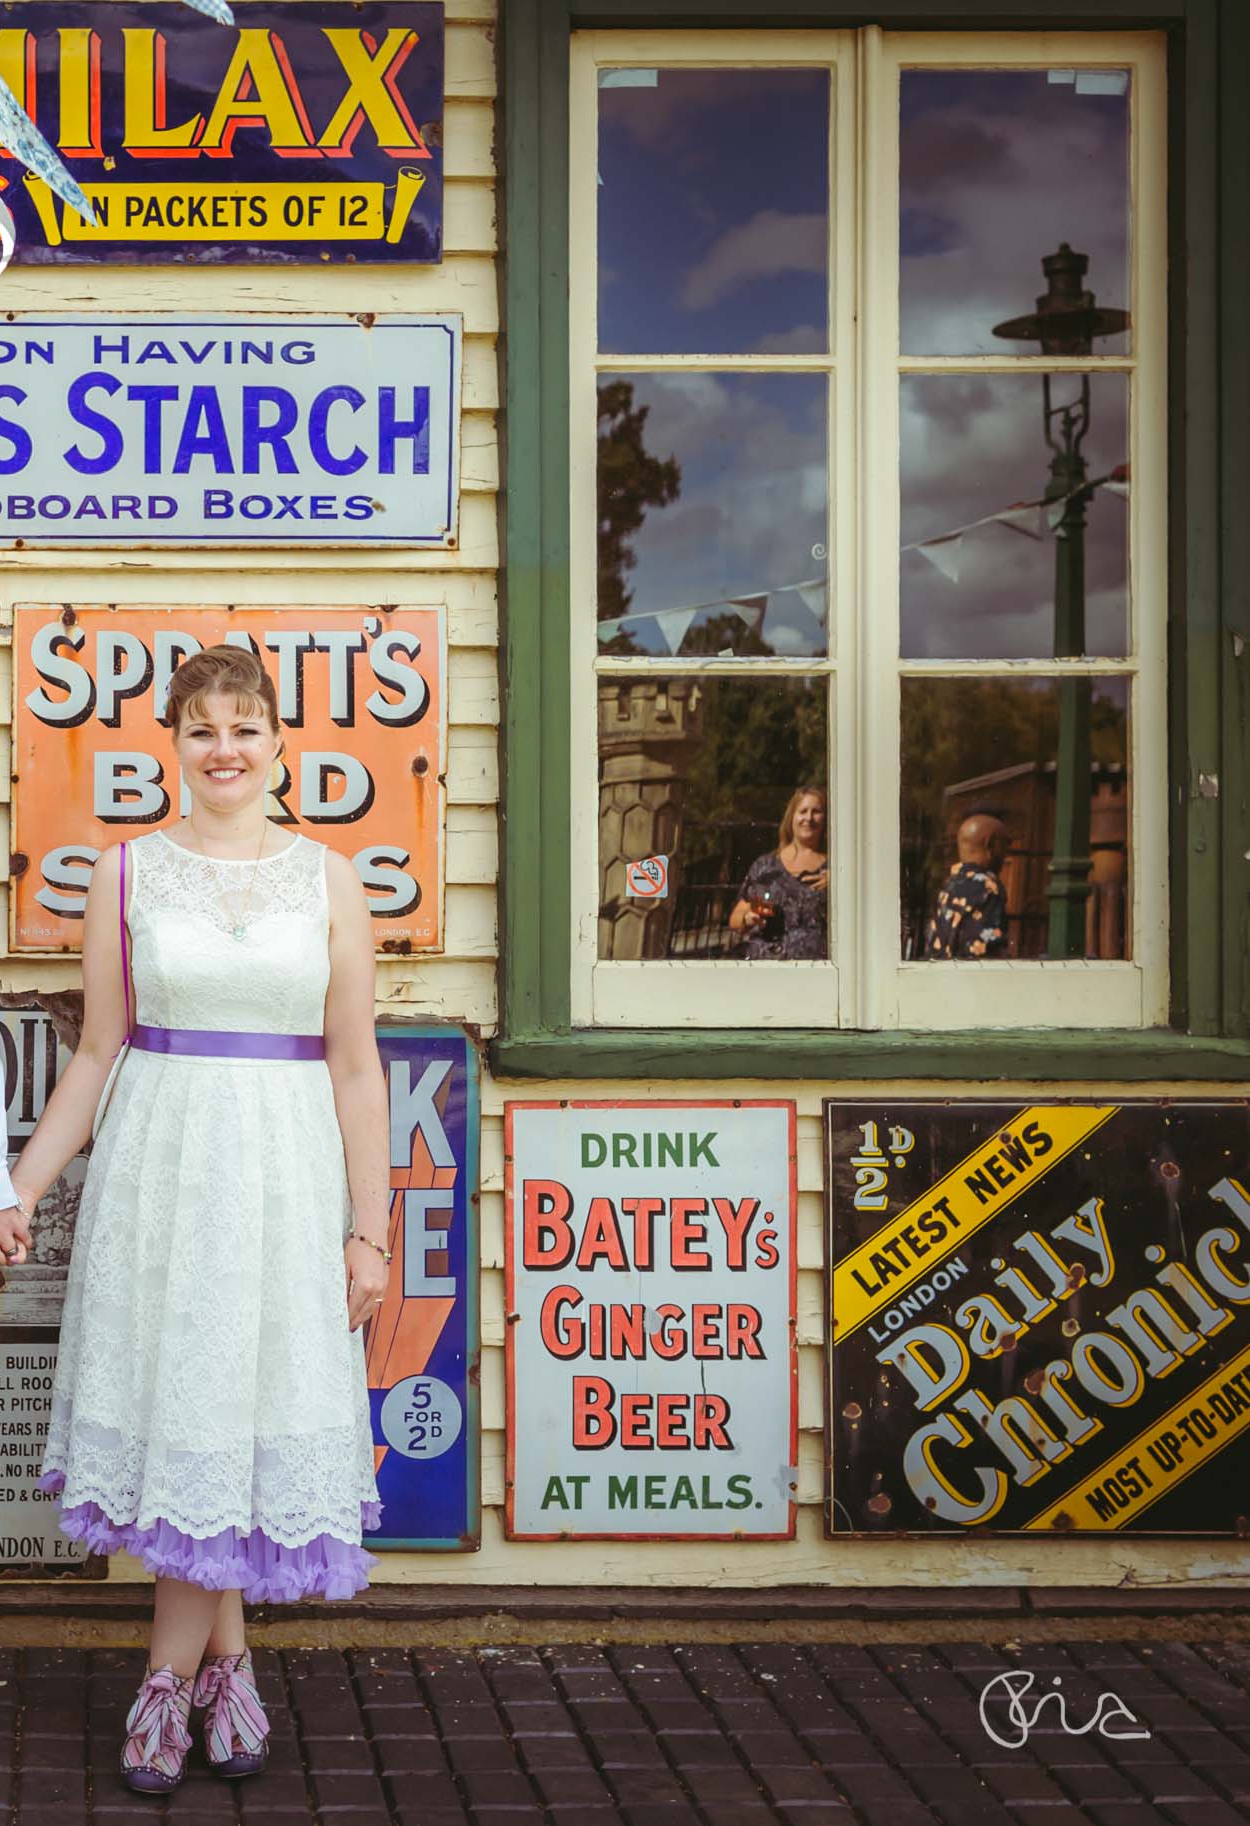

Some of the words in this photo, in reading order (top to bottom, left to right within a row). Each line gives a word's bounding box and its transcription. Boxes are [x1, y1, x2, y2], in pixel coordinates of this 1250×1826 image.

[125, 195, 268, 227] PACKETS
[283, 195, 326, 227] OF
[338, 195, 369, 227] 12
[92, 335, 316, 364] HAVING
[64, 371, 431, 475] STARCH
[203, 488, 374, 520] BOXES
[581, 1132, 720, 1168] DRINK
[851, 1196, 961, 1298] LATEST
[964, 1121, 1053, 1205] NEWS
[867, 1256, 970, 1344] LONDON
[875, 1197, 1116, 1412] Daily
[540, 1284, 767, 1361] GINGER
[412, 1383, 431, 1409] 5
[572, 1375, 735, 1451] BEER
[404, 1411, 442, 1422] FOR
[6, 1464, 22, 1477] NO
[19, 1489, 28, 1501] &
[540, 1475, 590, 1510] AT
[608, 1475, 763, 1510] MEALS.
[1085, 1456, 1153, 1523] MOST
